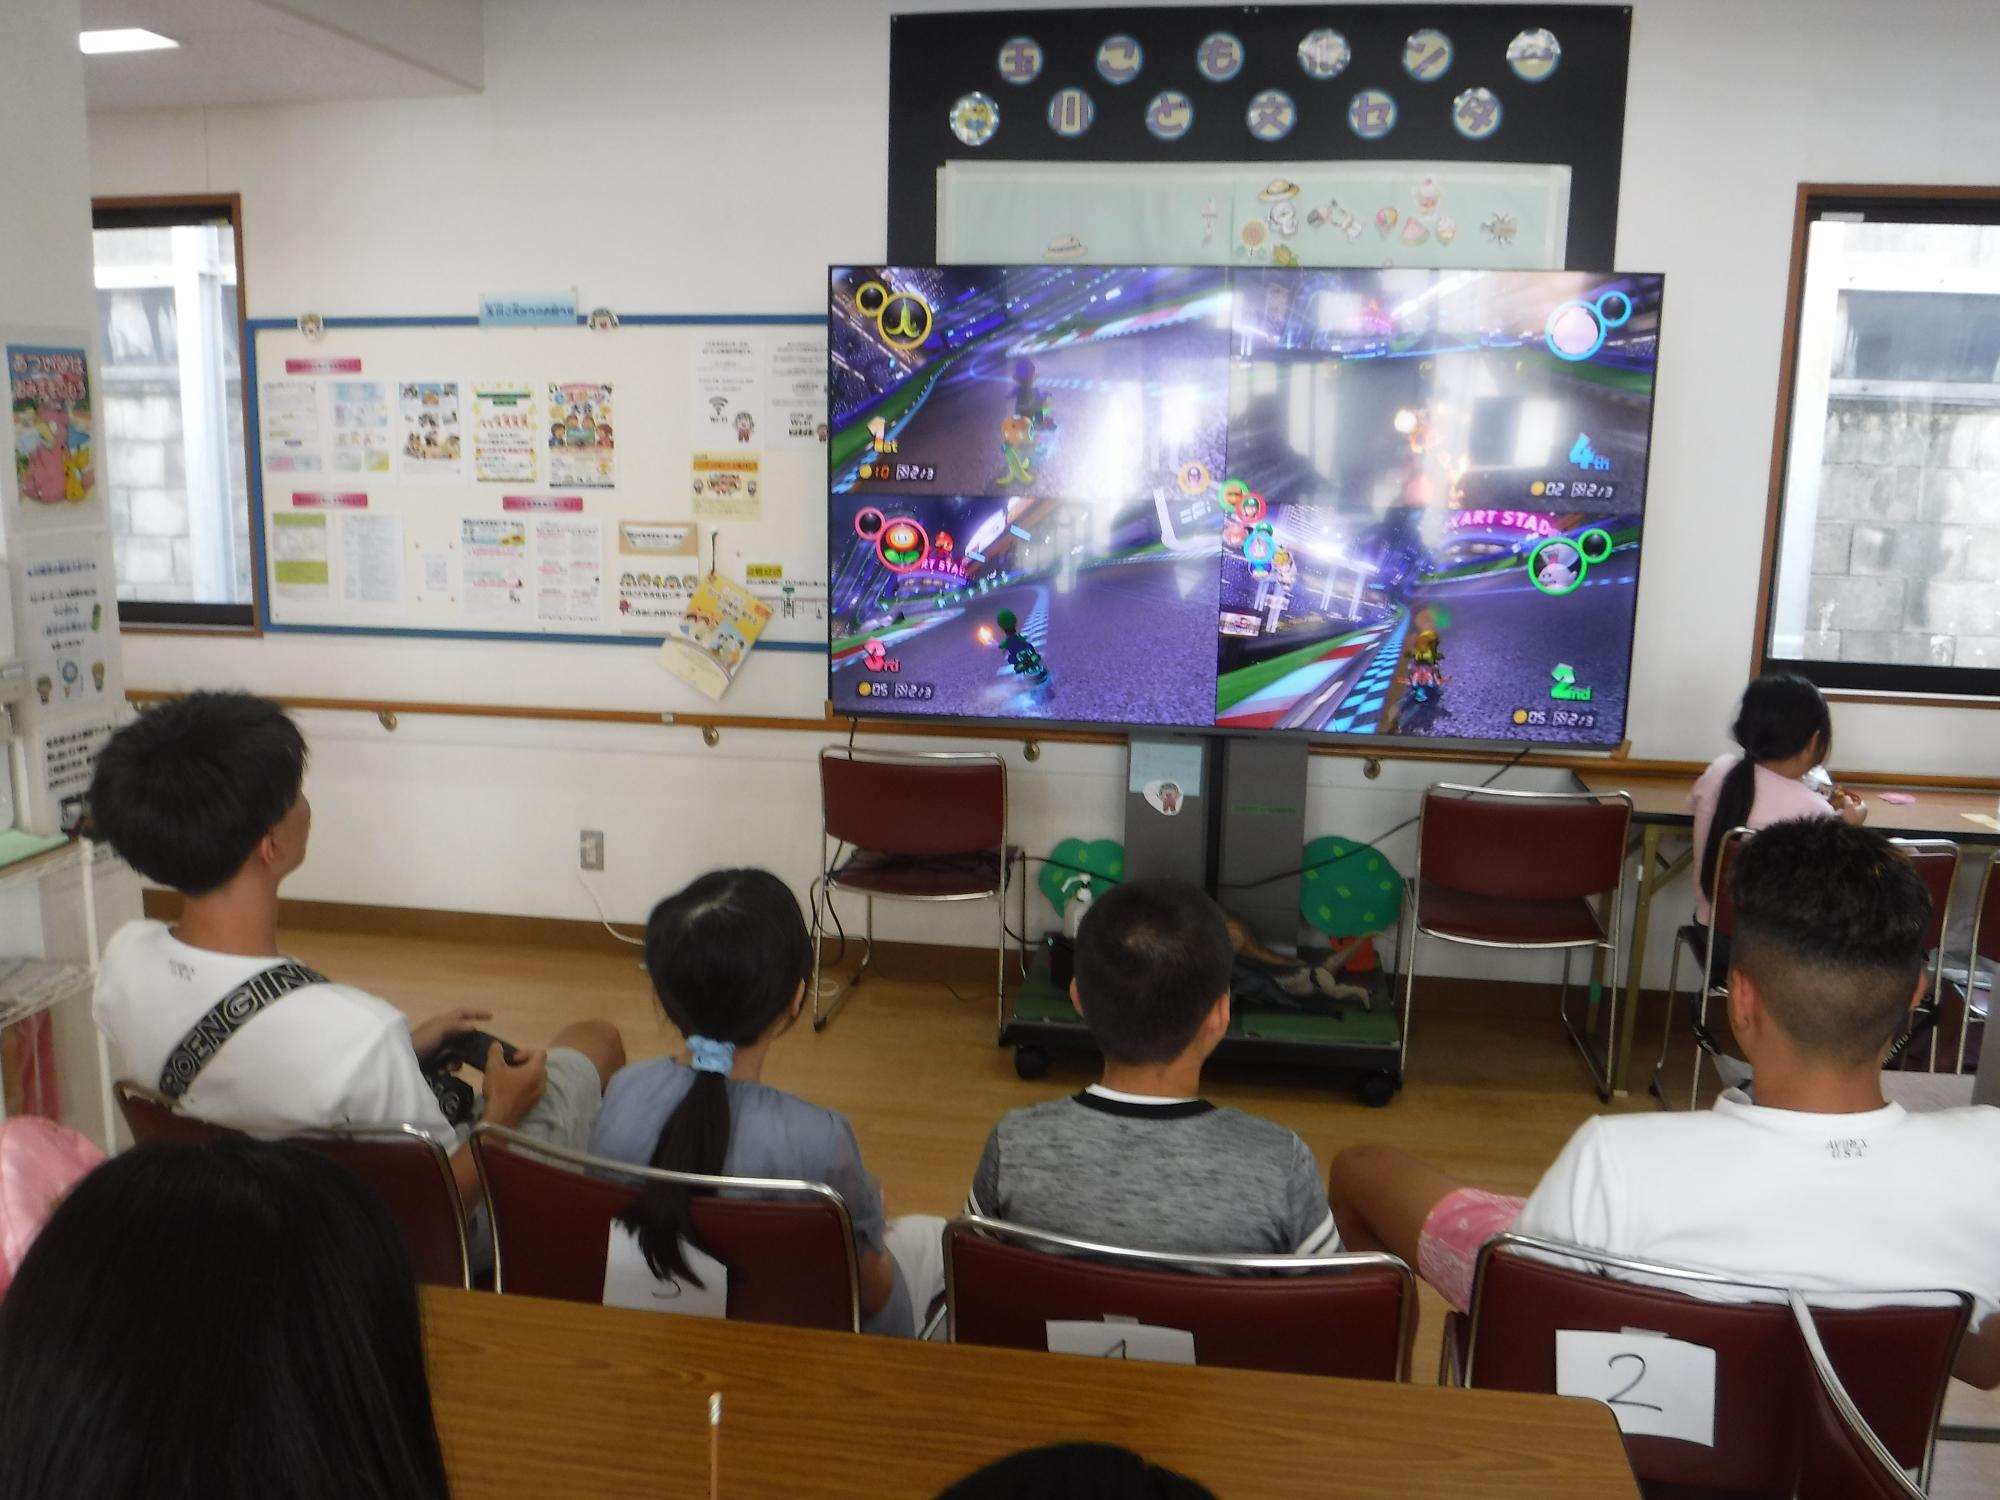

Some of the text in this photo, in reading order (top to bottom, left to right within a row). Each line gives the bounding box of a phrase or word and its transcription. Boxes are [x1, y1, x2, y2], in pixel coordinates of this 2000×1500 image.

[1569, 432, 1611, 472] 4th
[1544, 481, 1565, 497] 02
[864, 638, 901, 673] 3rd
[1551, 662, 1593, 702] 2nd
[1528, 711, 1547, 725] 05
[1606, 1352, 1664, 1413] 2
